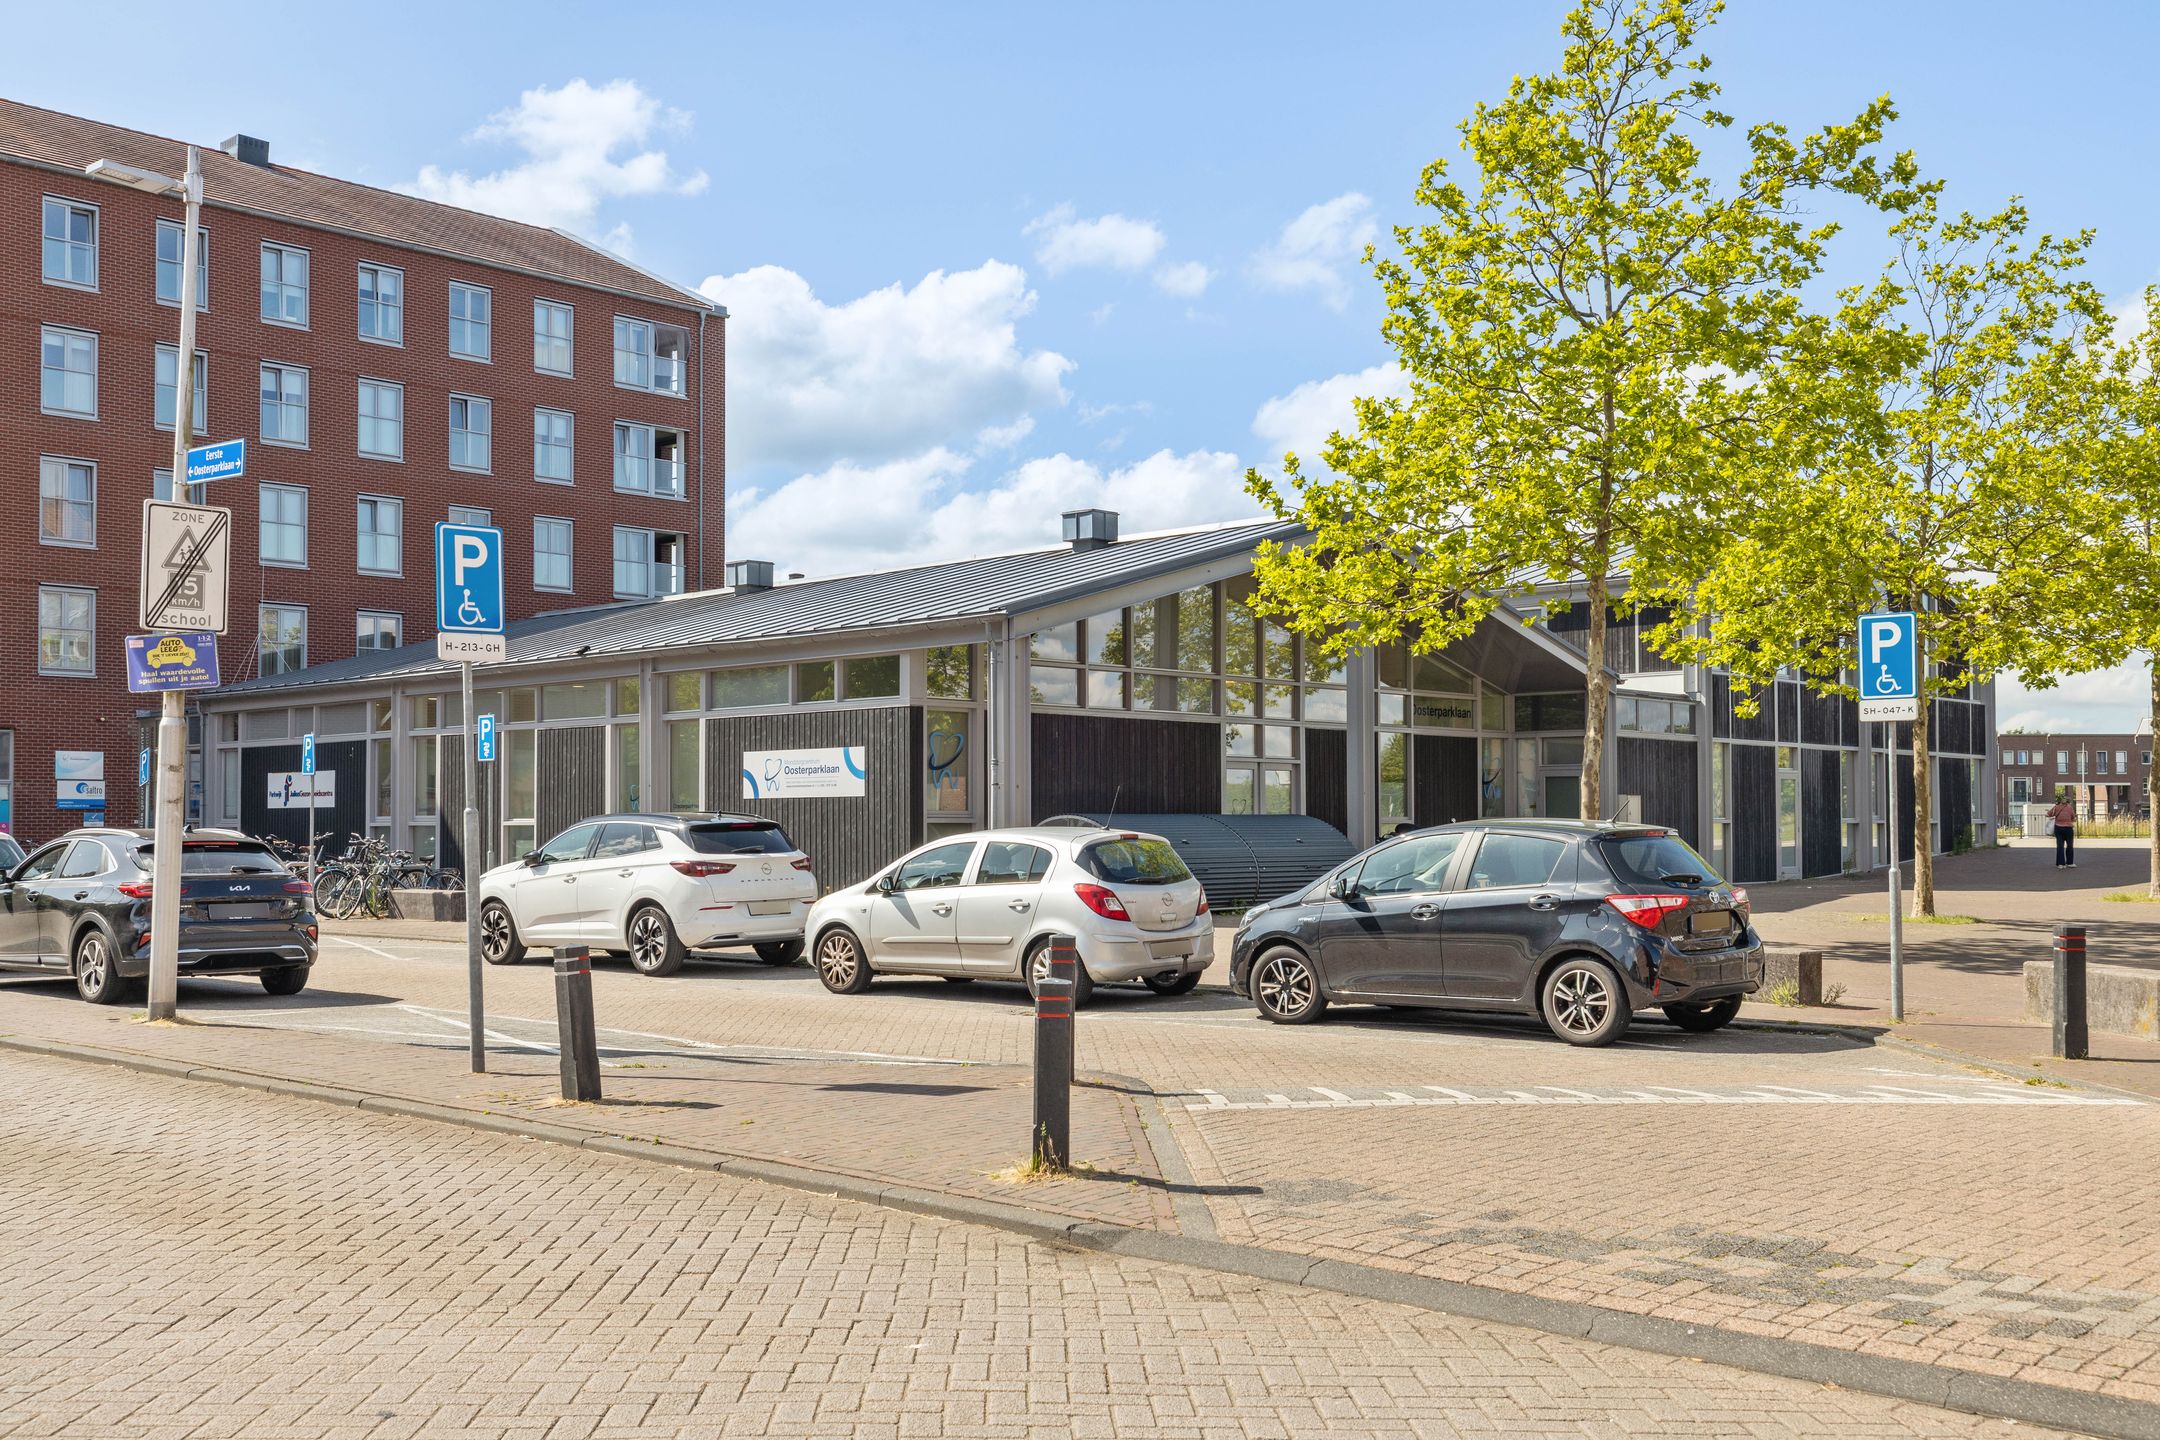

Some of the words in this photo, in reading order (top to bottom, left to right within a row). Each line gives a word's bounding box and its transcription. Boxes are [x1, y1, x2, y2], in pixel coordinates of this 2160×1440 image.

[205, 450, 223, 461] Eerste
[193, 461, 235, 475] Oosterparklaan
[172, 511, 205, 524] ZONE
[454, 534, 488, 586] P
[171, 597, 201, 607] km/h
[161, 613, 211, 627] school
[160, 639, 181, 647] AUTO
[445, 641, 501, 653] H-213-GH
[1871, 621, 1902, 664] P
[160, 645, 184, 653] LEEG?
[160, 667, 206, 676] waardevolle
[138, 677, 166, 685] spullen
[1863, 705, 1914, 715] SH-047-K
[481, 719, 491, 741] P
[305, 738, 312, 757] P
[141, 753, 147, 771] P
[784, 765, 840, 776] Oosterparklaan
